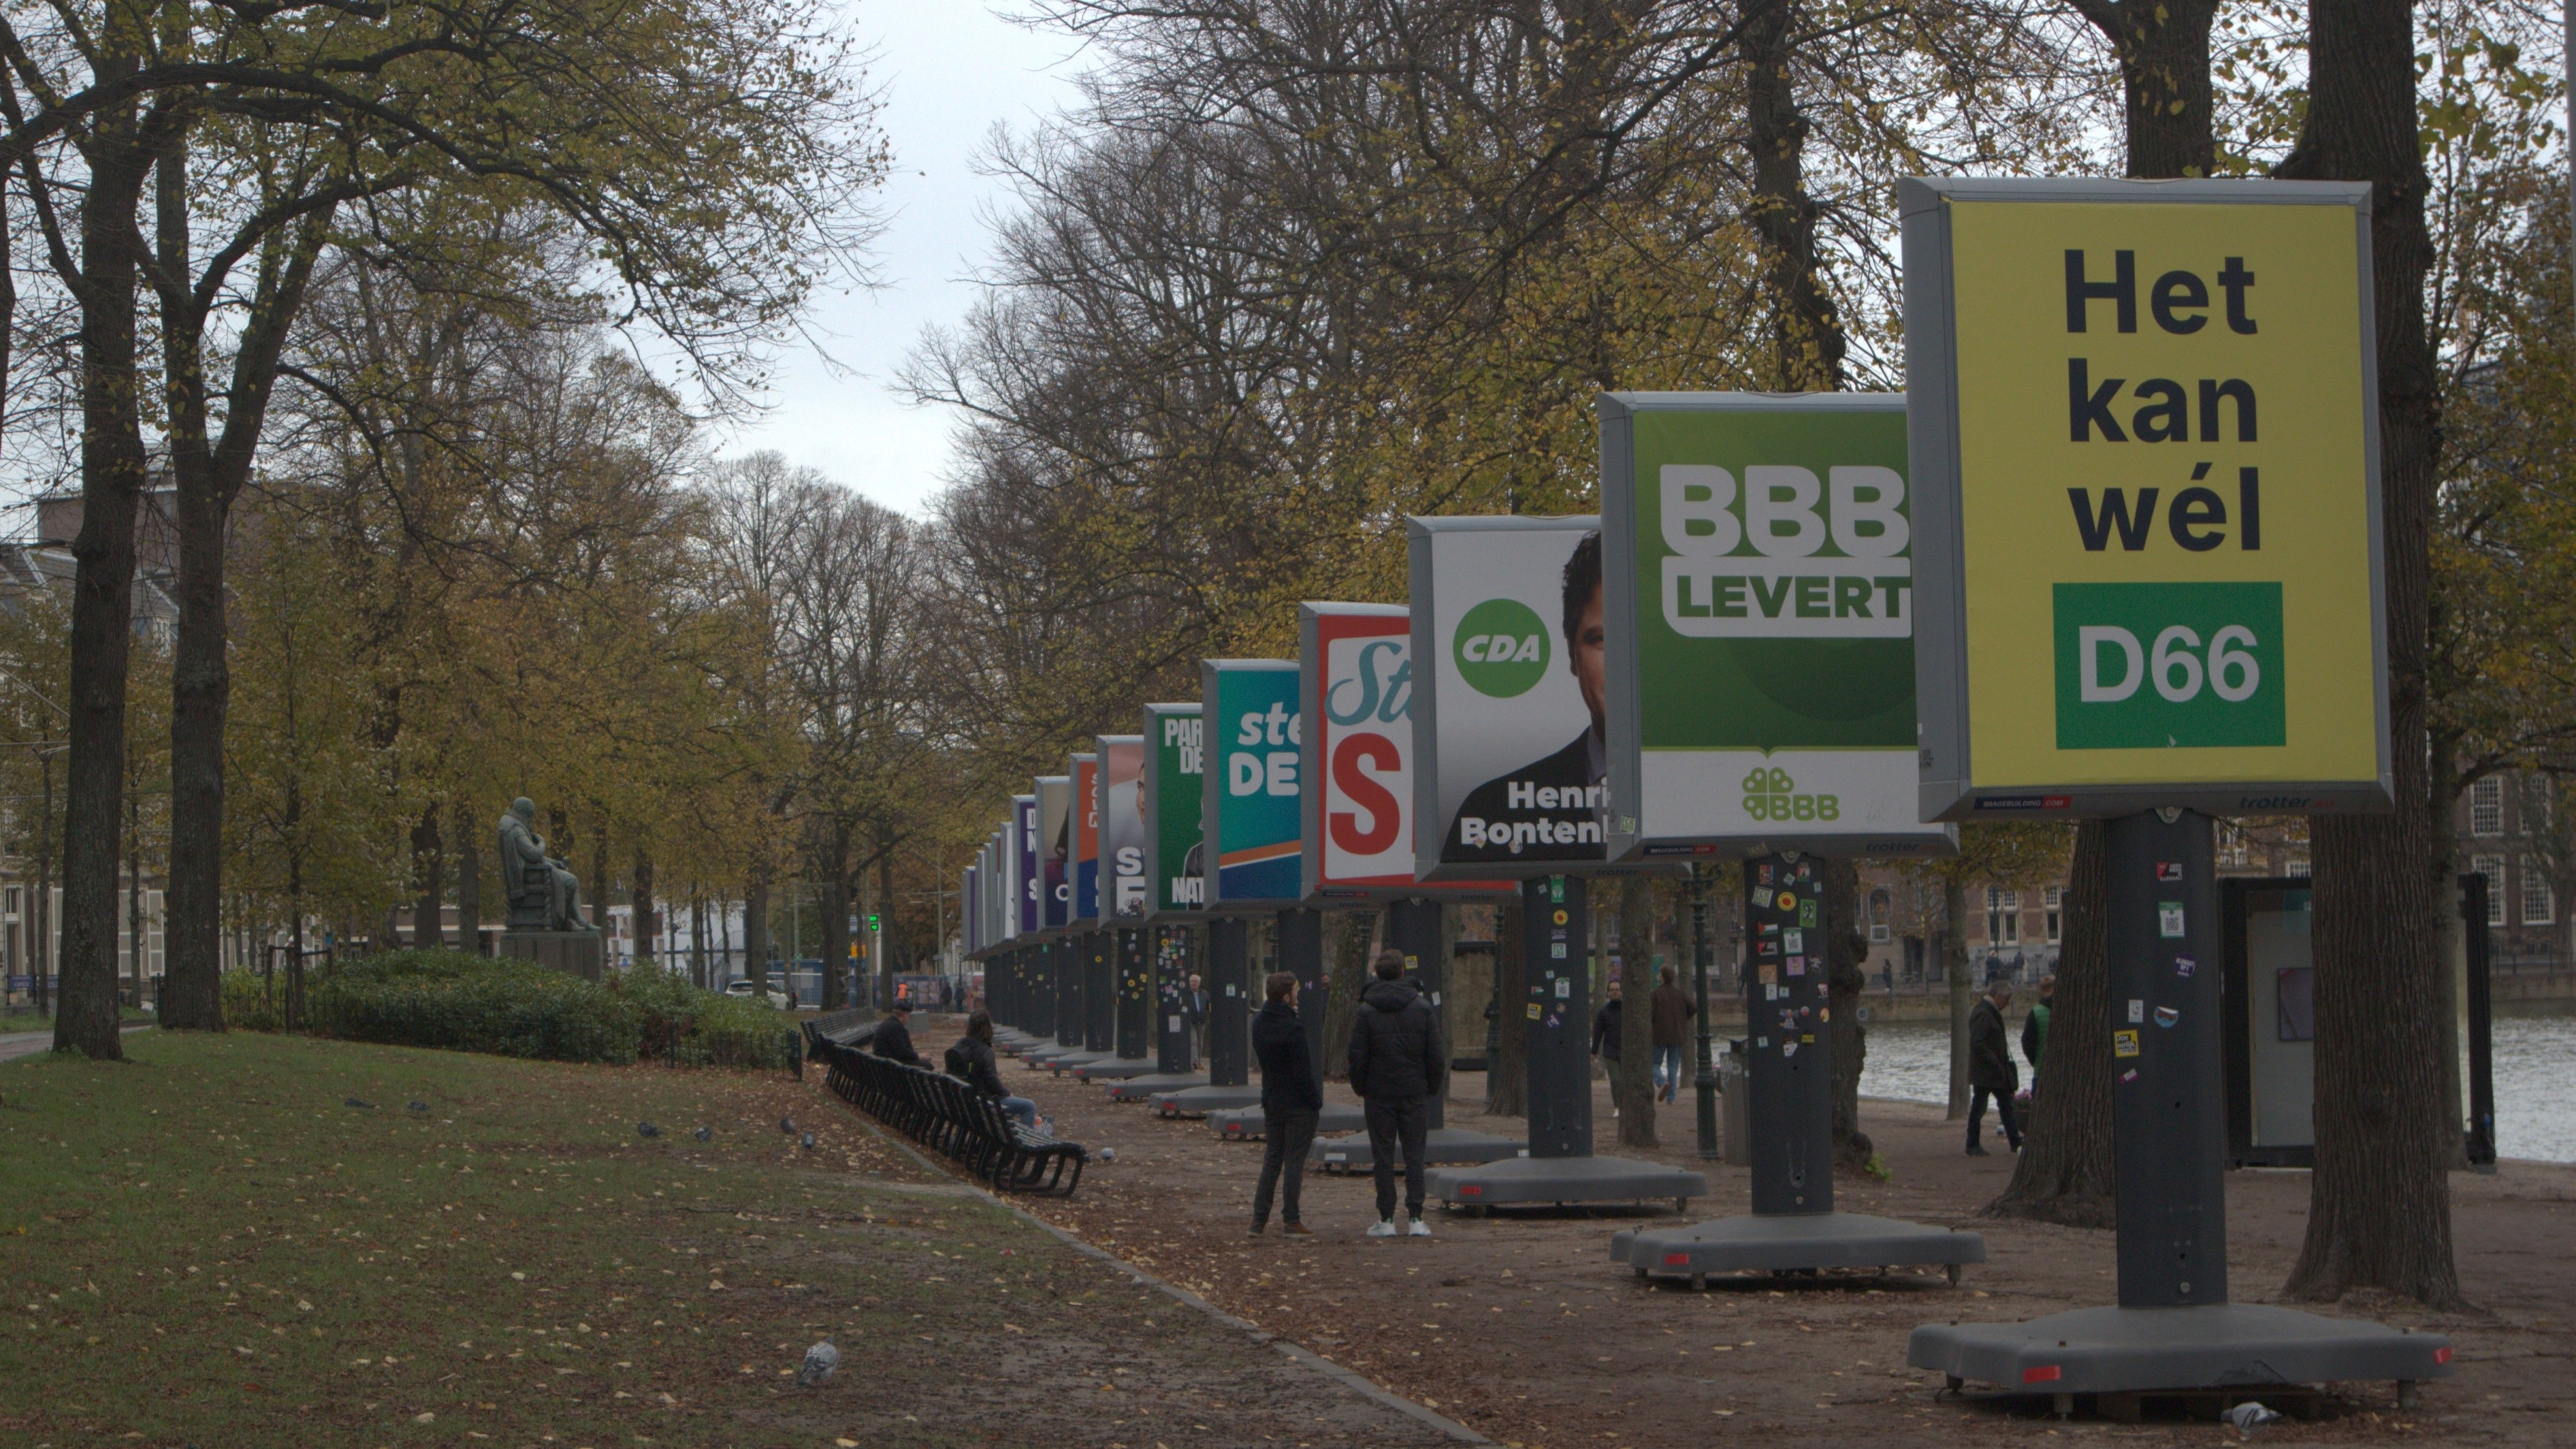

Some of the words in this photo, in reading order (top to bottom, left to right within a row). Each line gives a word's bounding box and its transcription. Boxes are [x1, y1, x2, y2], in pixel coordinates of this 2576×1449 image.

[2064, 249, 2258, 335] Het
[2067, 357, 2258, 443] kan
[1660, 464, 1910, 558] BBB
[2067, 461, 2260, 552] wél
[1676, 575, 1912, 618] LEVERT
[1323, 641, 1412, 727] St
[1462, 634, 1540, 663] CDA
[2079, 624, 2260, 703] D66
[1229, 752, 1300, 797] DE
[1329, 732, 1414, 856] S
[1508, 777, 1608, 809] Henri
[1769, 794, 1840, 822] BBB
